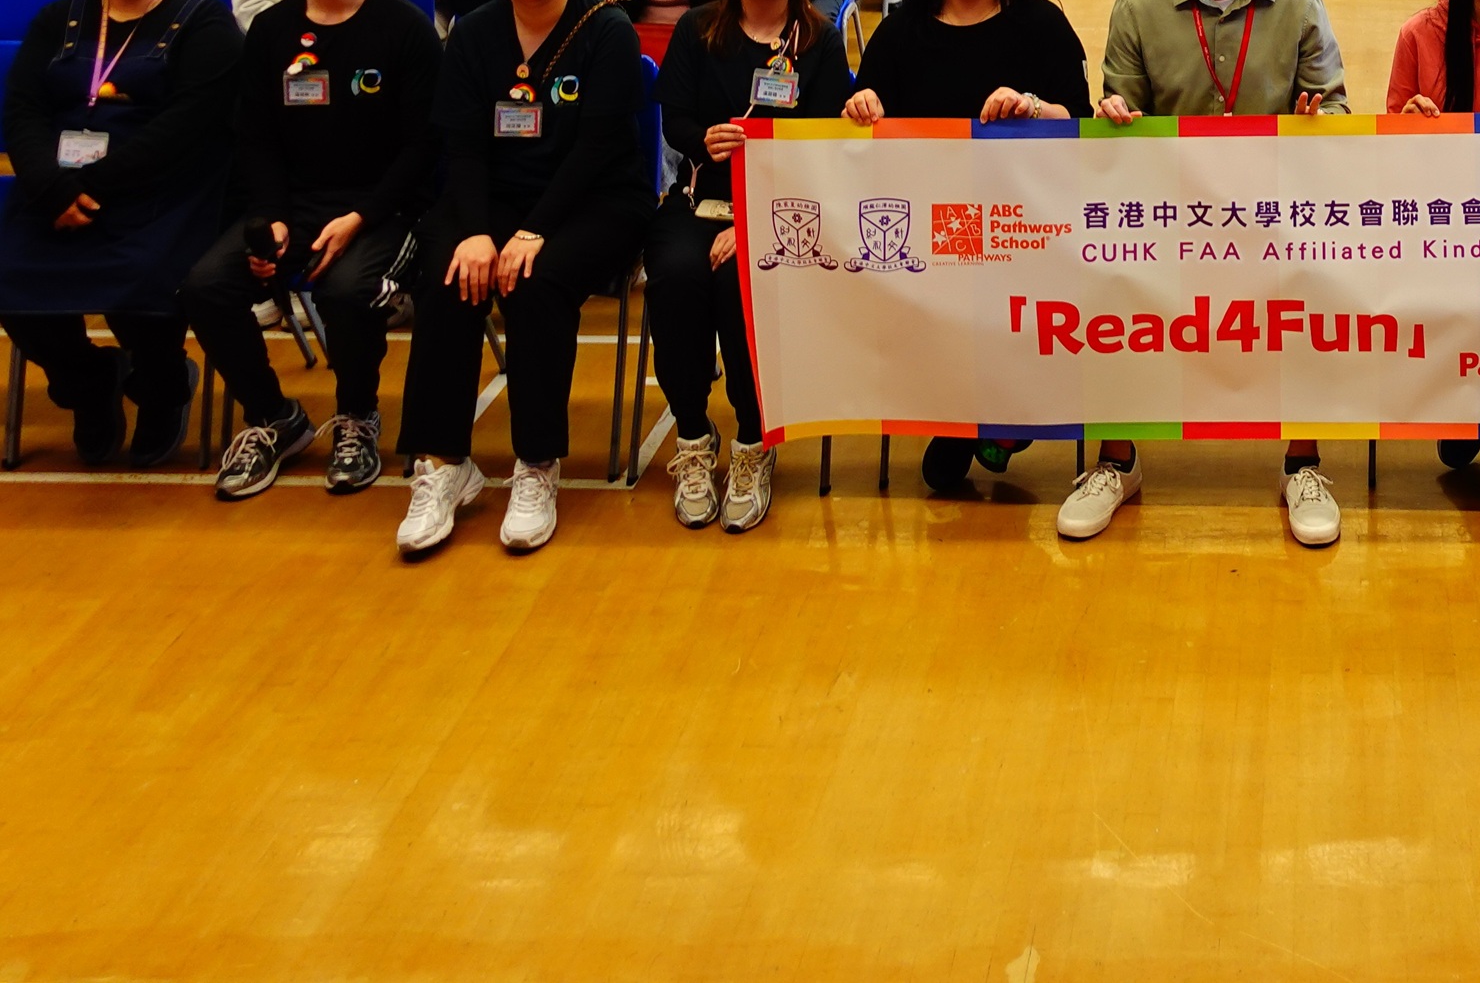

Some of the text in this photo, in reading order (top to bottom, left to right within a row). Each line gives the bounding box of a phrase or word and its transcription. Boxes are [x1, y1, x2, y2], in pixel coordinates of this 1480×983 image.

[989, 204, 1024, 218] ABC
[990, 220, 1072, 236] Pathways
[958, 254, 1012, 262] PATHWAYS
[1082, 242, 1158, 262] CUHK
[1179, 241, 1241, 260] FAA
[1262, 240, 1402, 261] Affiliated
